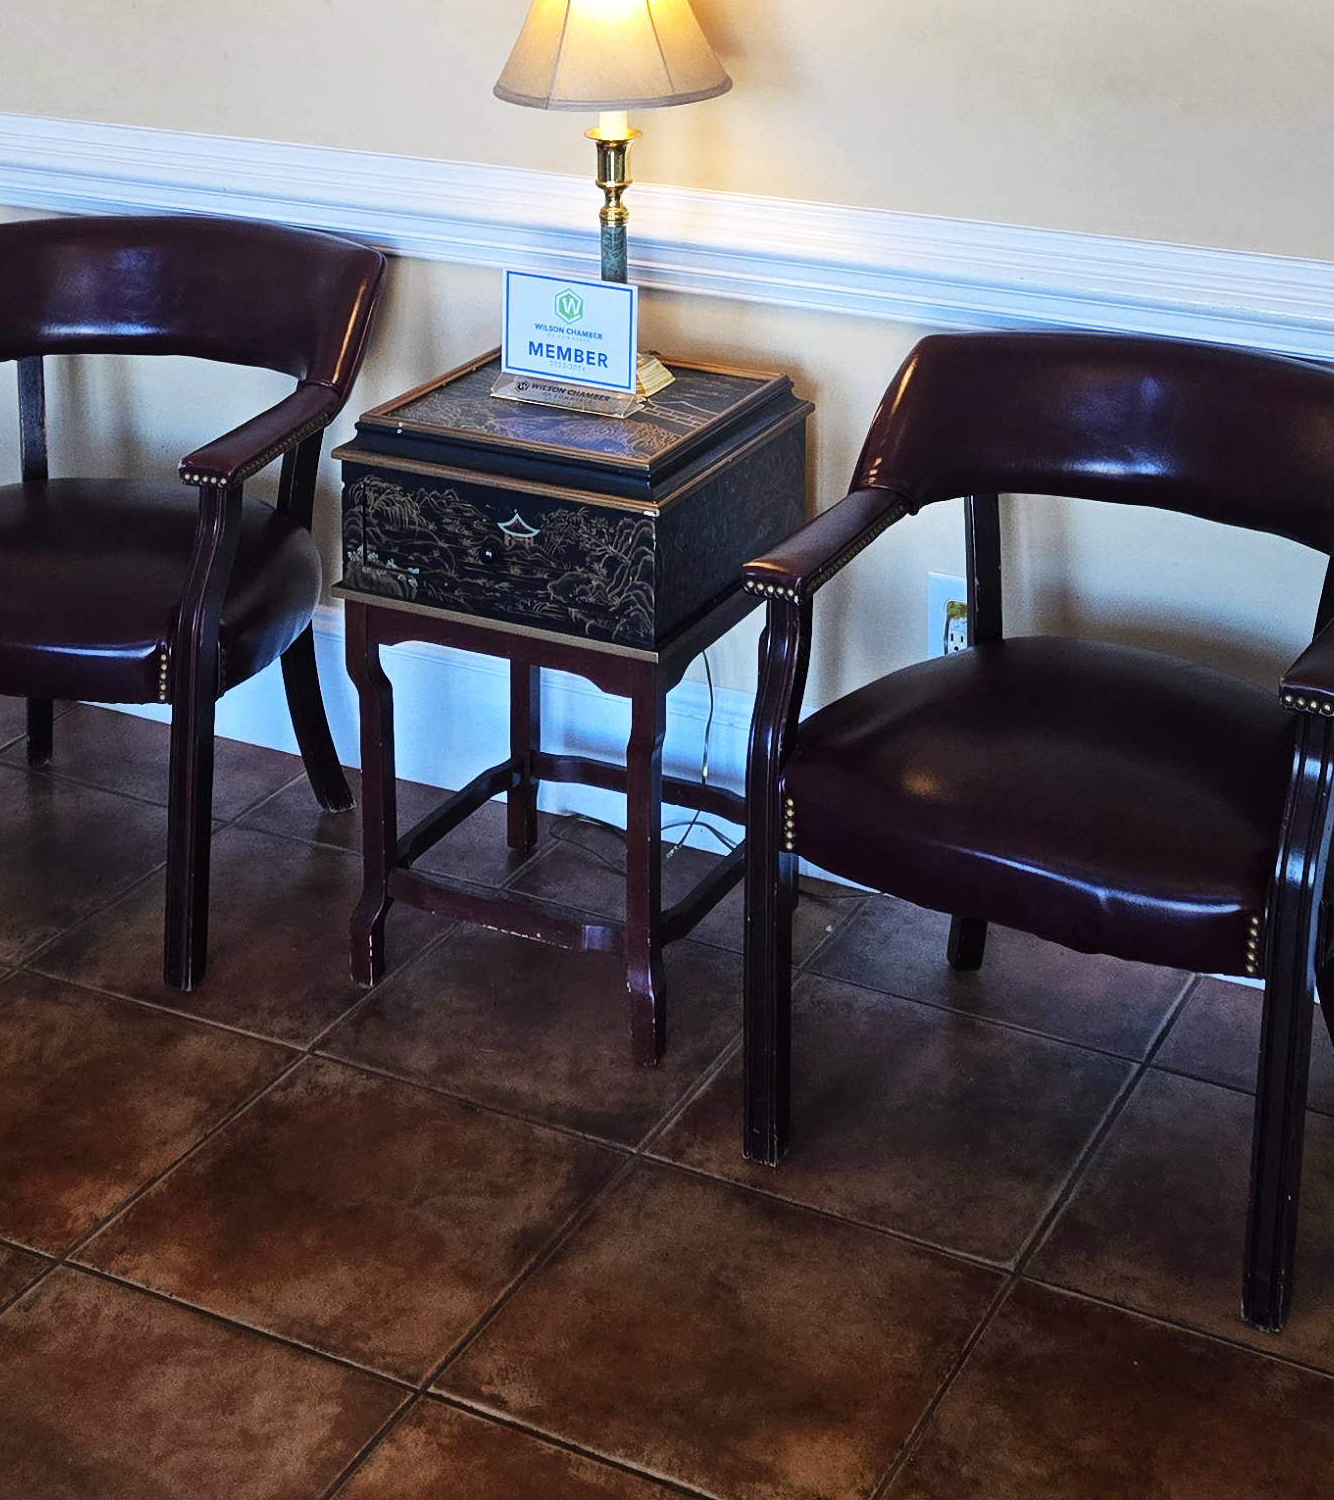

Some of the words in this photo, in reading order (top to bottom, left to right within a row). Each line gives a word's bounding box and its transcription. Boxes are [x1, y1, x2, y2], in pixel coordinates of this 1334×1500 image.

[535, 323, 564, 334] WILSON
[566, 328, 603, 340] CHAMBER
[528, 340, 608, 368] MEMBER
[550, 360, 586, 372] 2023-2024
[531, 382, 566, 394] WILSON
[567, 389, 611, 402] CHAMBER
